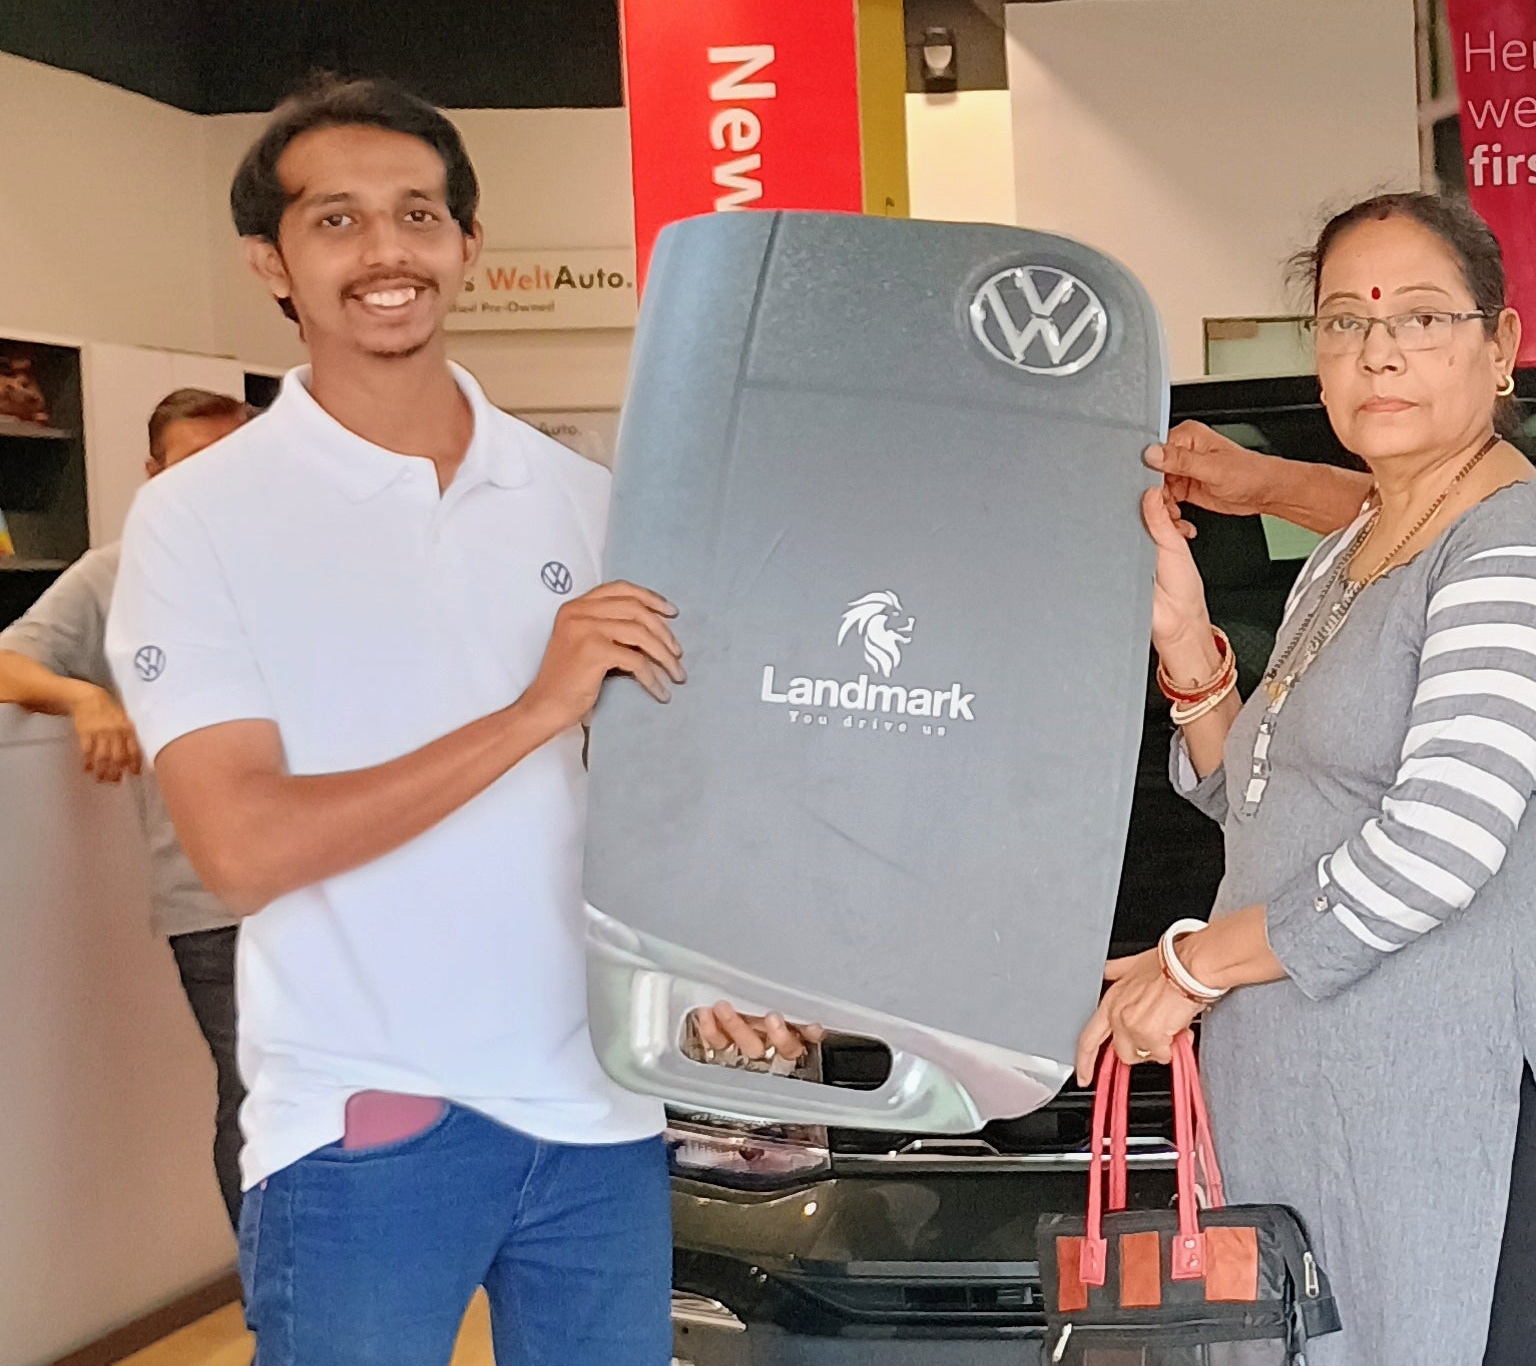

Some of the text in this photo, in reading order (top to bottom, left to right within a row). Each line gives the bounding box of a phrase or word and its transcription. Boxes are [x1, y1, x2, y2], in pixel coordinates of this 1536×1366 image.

[707, 44, 777, 212] New
[761, 665, 976, 721] Landmark
[788, 710, 946, 737] You drive us
